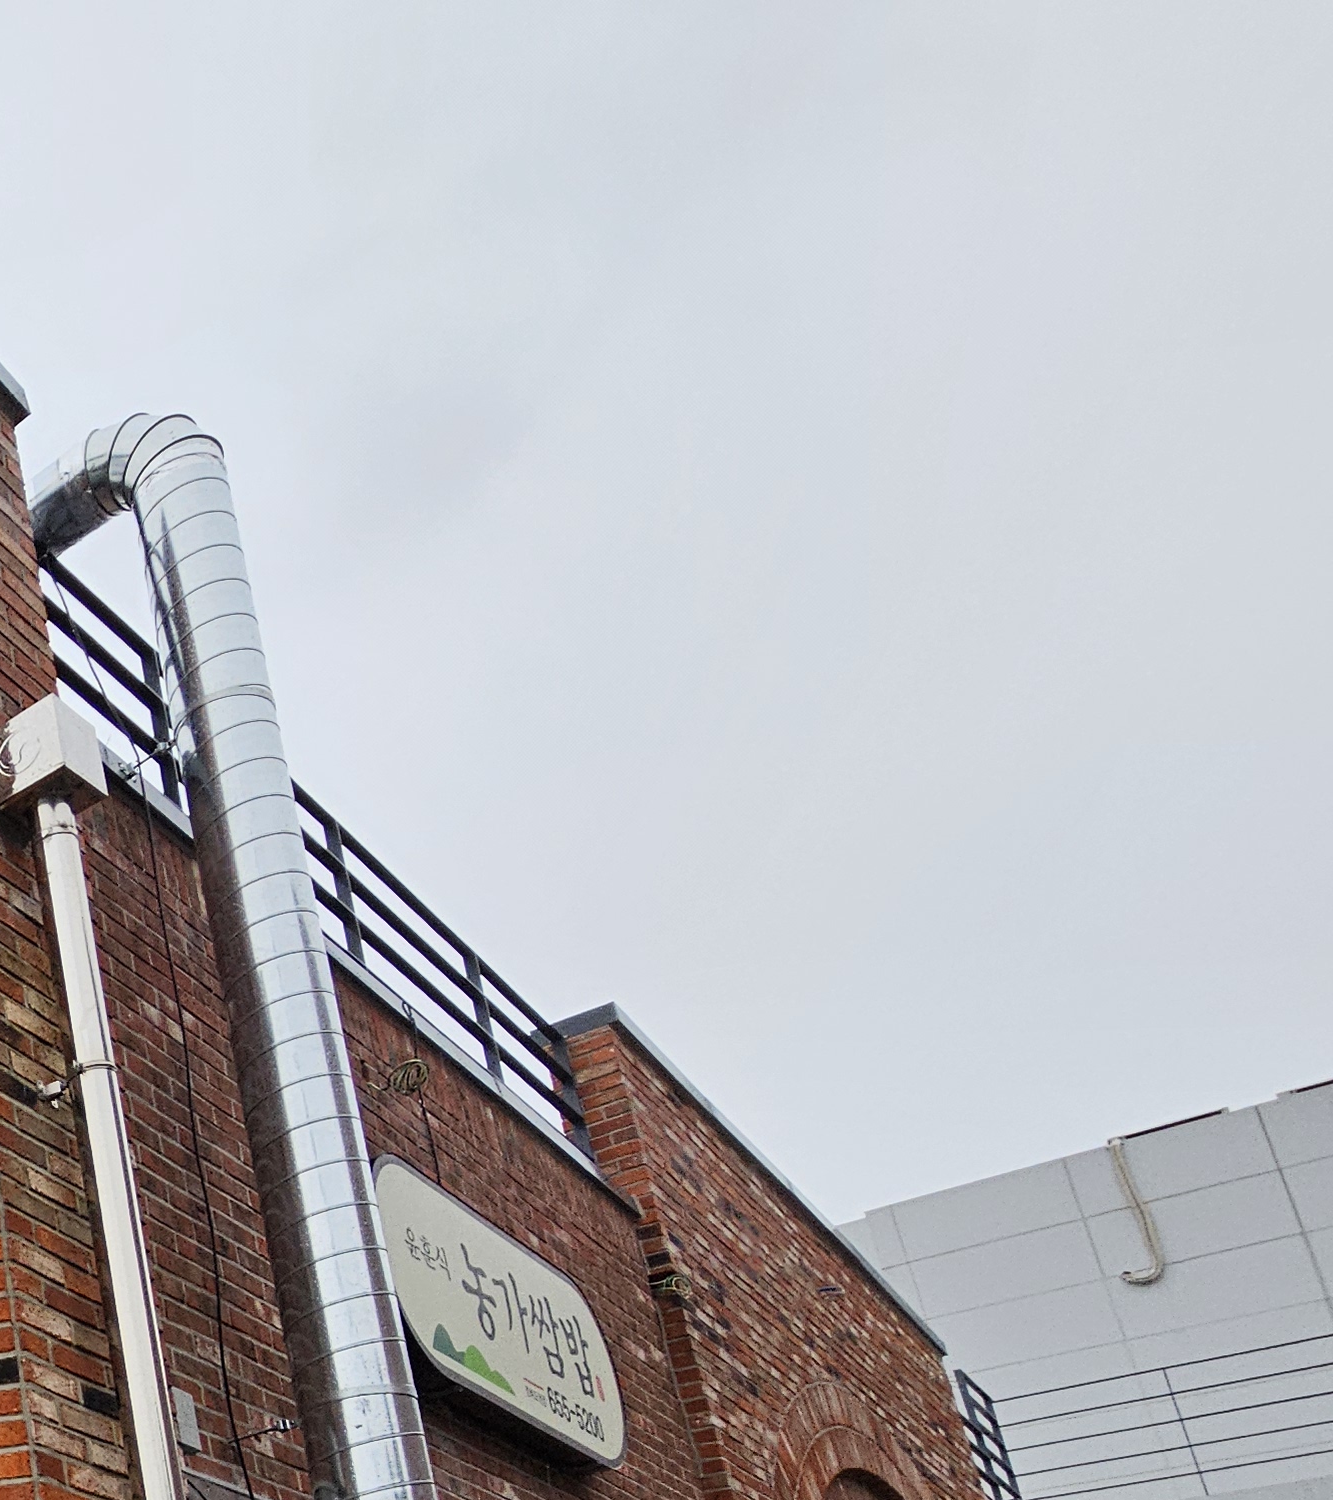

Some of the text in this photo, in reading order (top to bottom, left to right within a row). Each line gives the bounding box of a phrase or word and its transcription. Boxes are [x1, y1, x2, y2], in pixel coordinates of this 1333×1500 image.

[404, 1226, 595, 1399] 윤훈식 농가쌈밥
[546, 1386, 605, 1442] 655-5200
